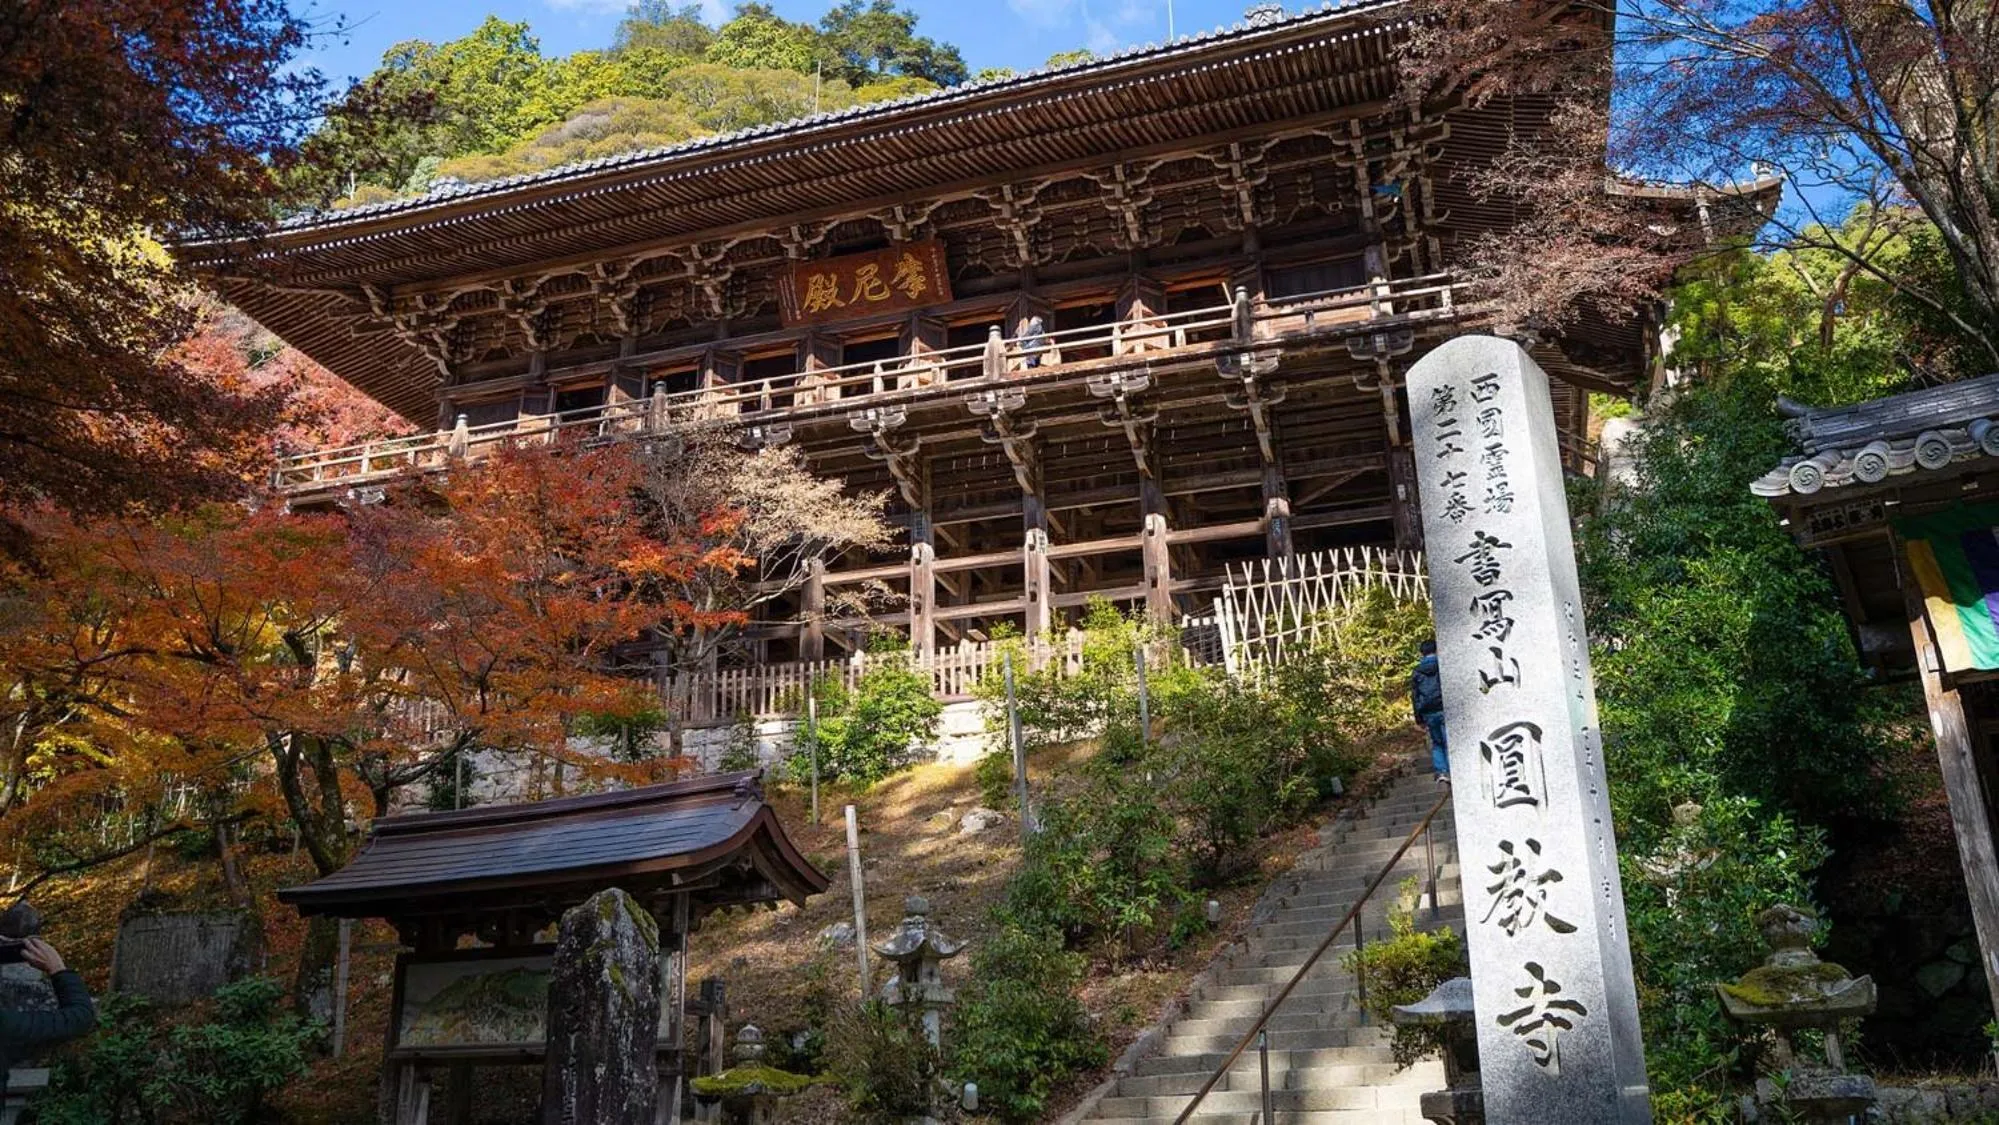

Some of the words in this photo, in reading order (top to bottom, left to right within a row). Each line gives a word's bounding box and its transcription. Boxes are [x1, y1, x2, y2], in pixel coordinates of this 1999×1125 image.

[803, 252, 927, 313] 摩尼殿
[1430, 384, 1476, 525] 第二十七番
